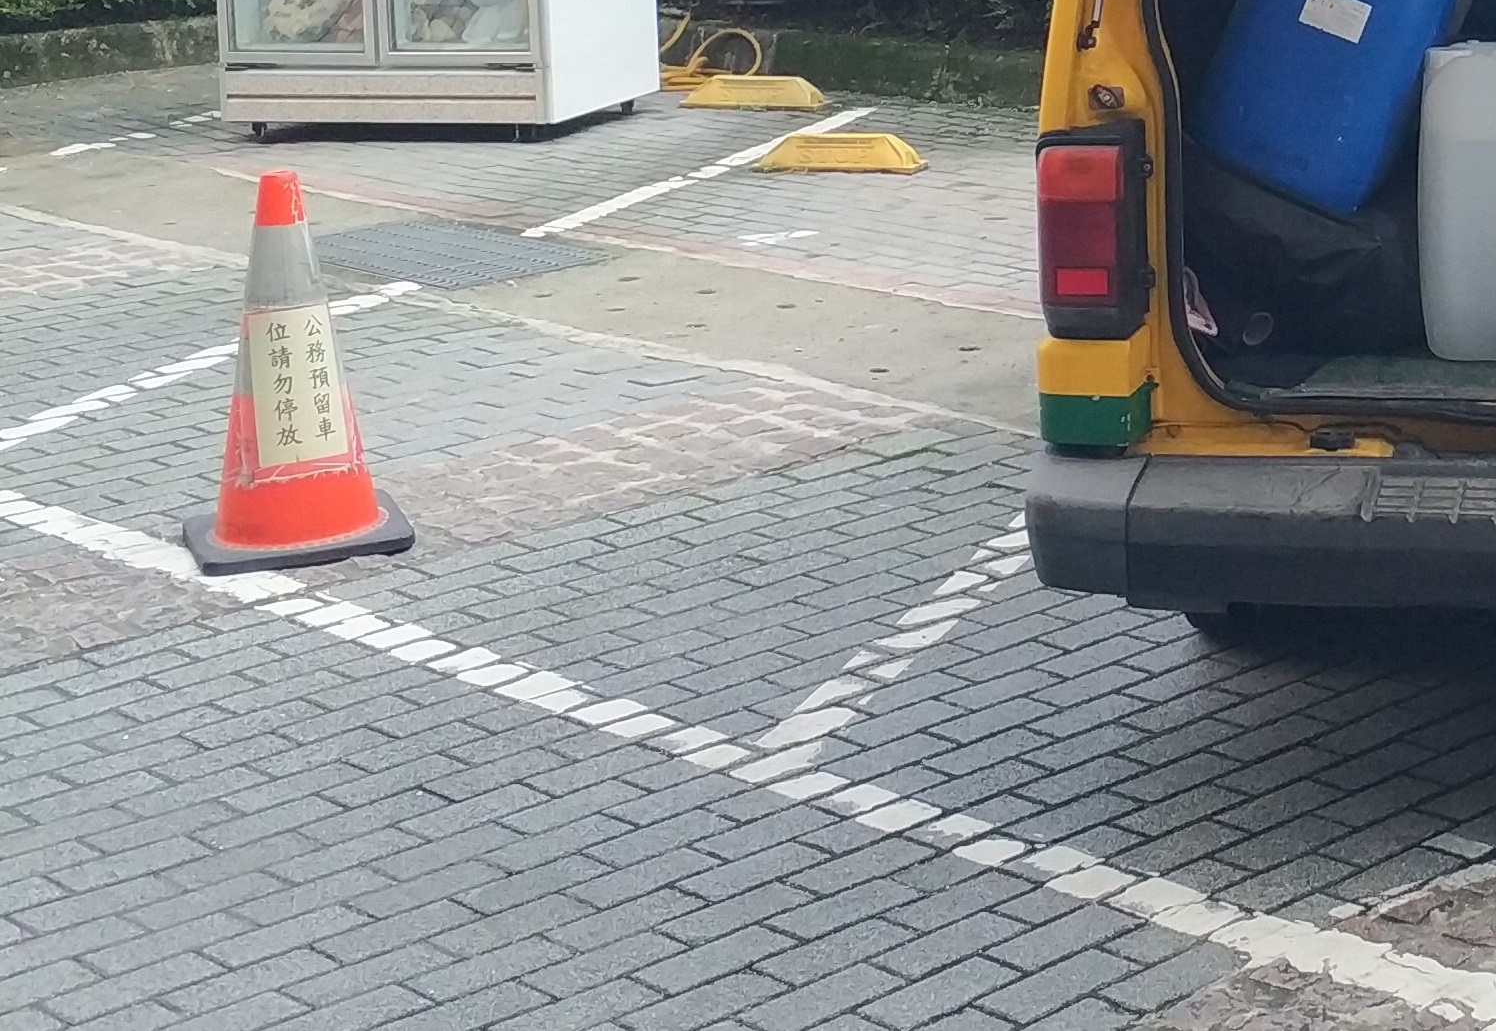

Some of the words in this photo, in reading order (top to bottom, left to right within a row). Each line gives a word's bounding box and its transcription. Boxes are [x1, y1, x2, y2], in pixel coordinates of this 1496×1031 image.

[266, 323, 303, 446] 位請勿停放
[304, 315, 336, 441] 公務預留車
